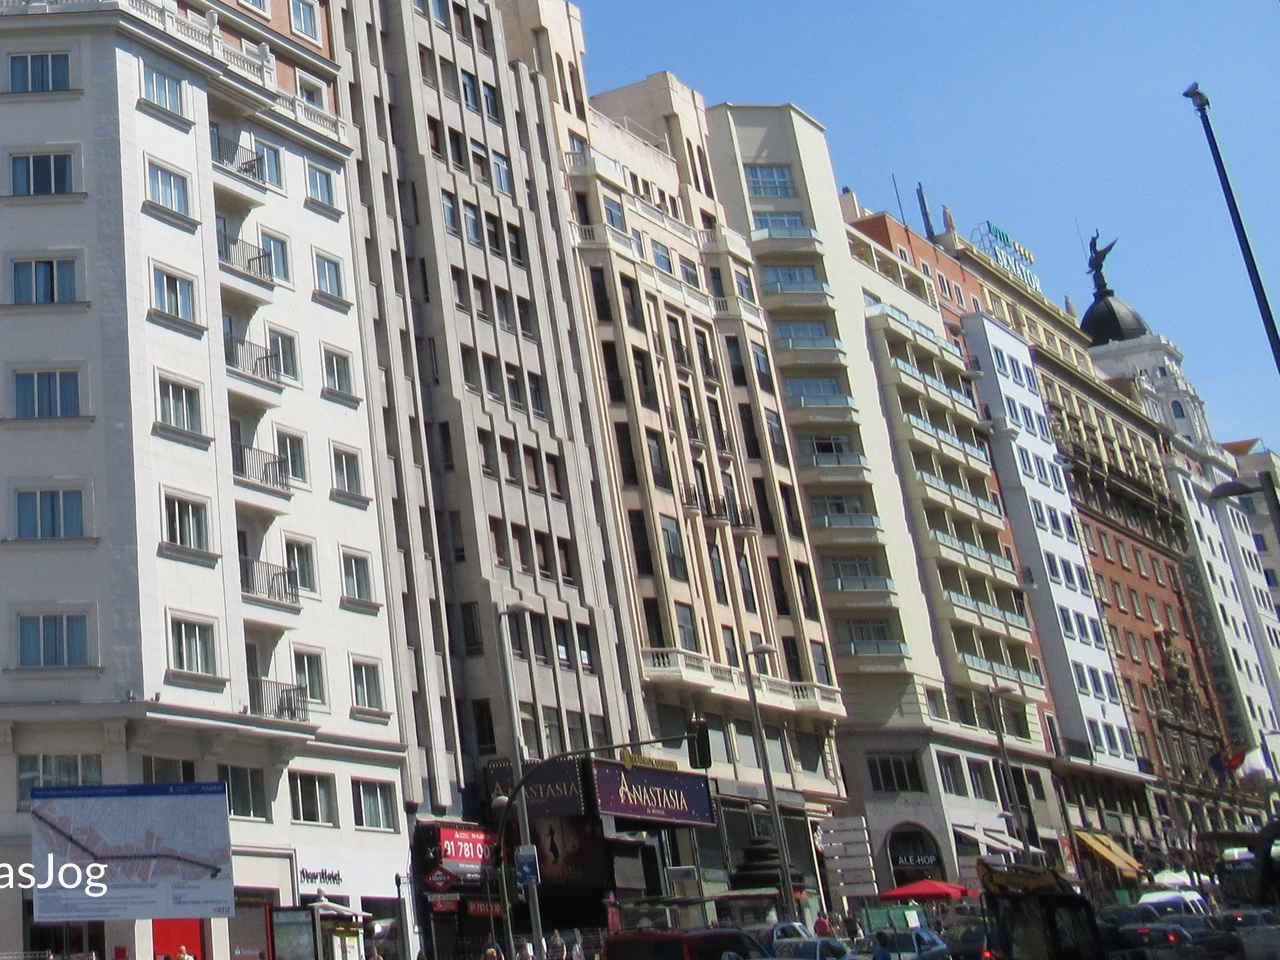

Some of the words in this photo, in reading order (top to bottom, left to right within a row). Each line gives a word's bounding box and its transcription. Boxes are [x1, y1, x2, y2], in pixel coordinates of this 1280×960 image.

[995, 246, 1043, 296] SENATOR
[619, 771, 689, 811] ANASTASIA
[444, 840, 455, 857] 91
[458, 841, 474, 858] 781
[898, 855, 936, 865] ALE-HOP
